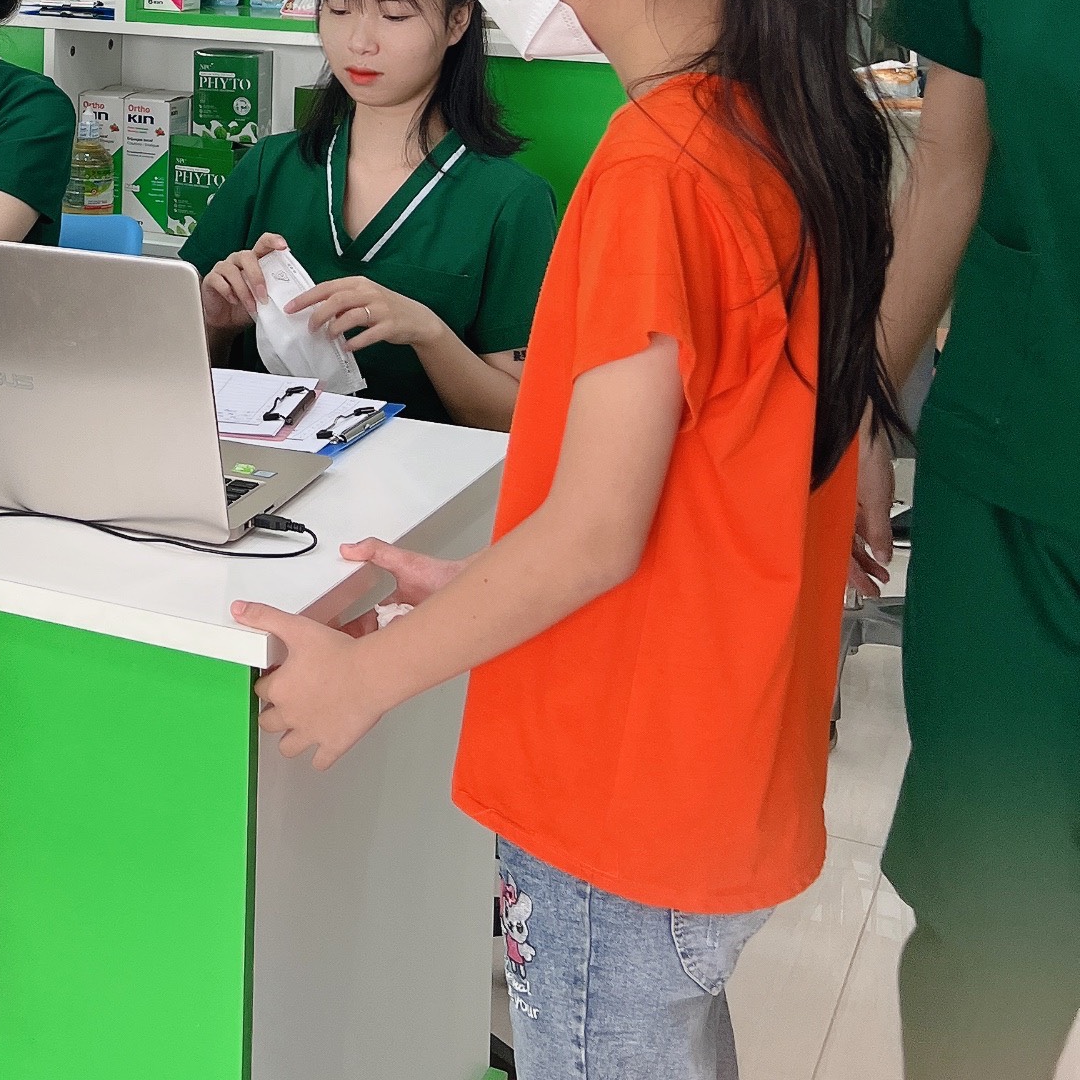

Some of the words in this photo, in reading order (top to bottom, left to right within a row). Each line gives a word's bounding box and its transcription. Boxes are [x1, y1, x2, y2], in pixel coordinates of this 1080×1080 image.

[199, 76, 251, 91] PHYTO
[83, 100, 105, 110] Ortho
[128, 104, 151, 114] Ortho
[83, 110, 109, 121] IN
[175, 170, 226, 188] PHYTO
